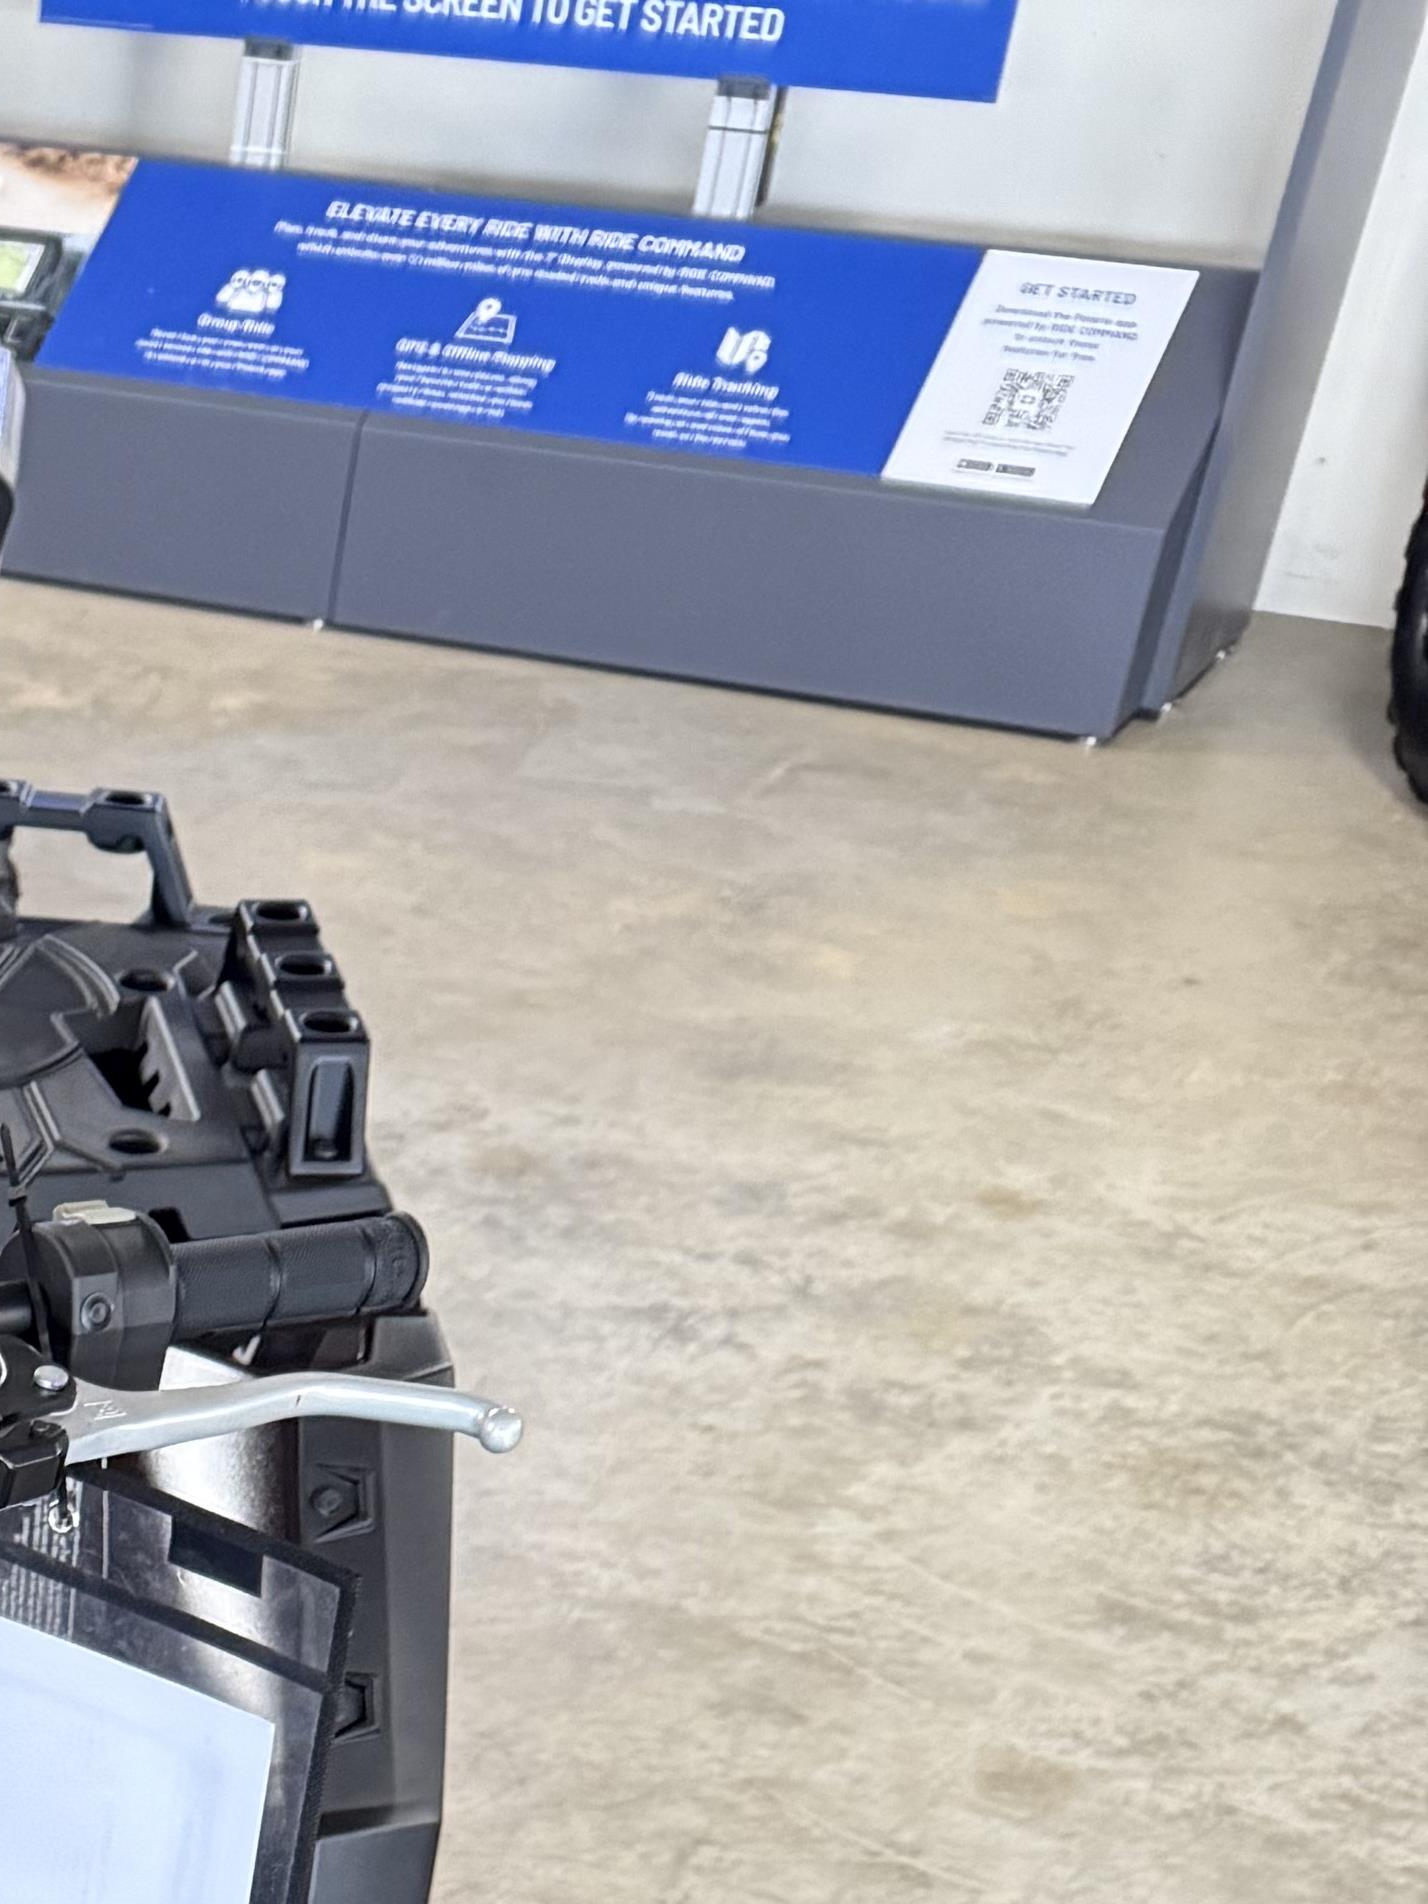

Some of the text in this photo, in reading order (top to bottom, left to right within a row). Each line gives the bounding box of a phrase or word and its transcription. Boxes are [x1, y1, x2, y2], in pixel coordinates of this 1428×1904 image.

[532, 0, 570, 25] TO
[574, 0, 639, 30] GET
[640, 0, 785, 42] STARTED
[326, 200, 746, 262] ELEVATE EVERY RIDE WITH RIDE COMMAND
[1020, 282, 1137, 306] GET STARTED
